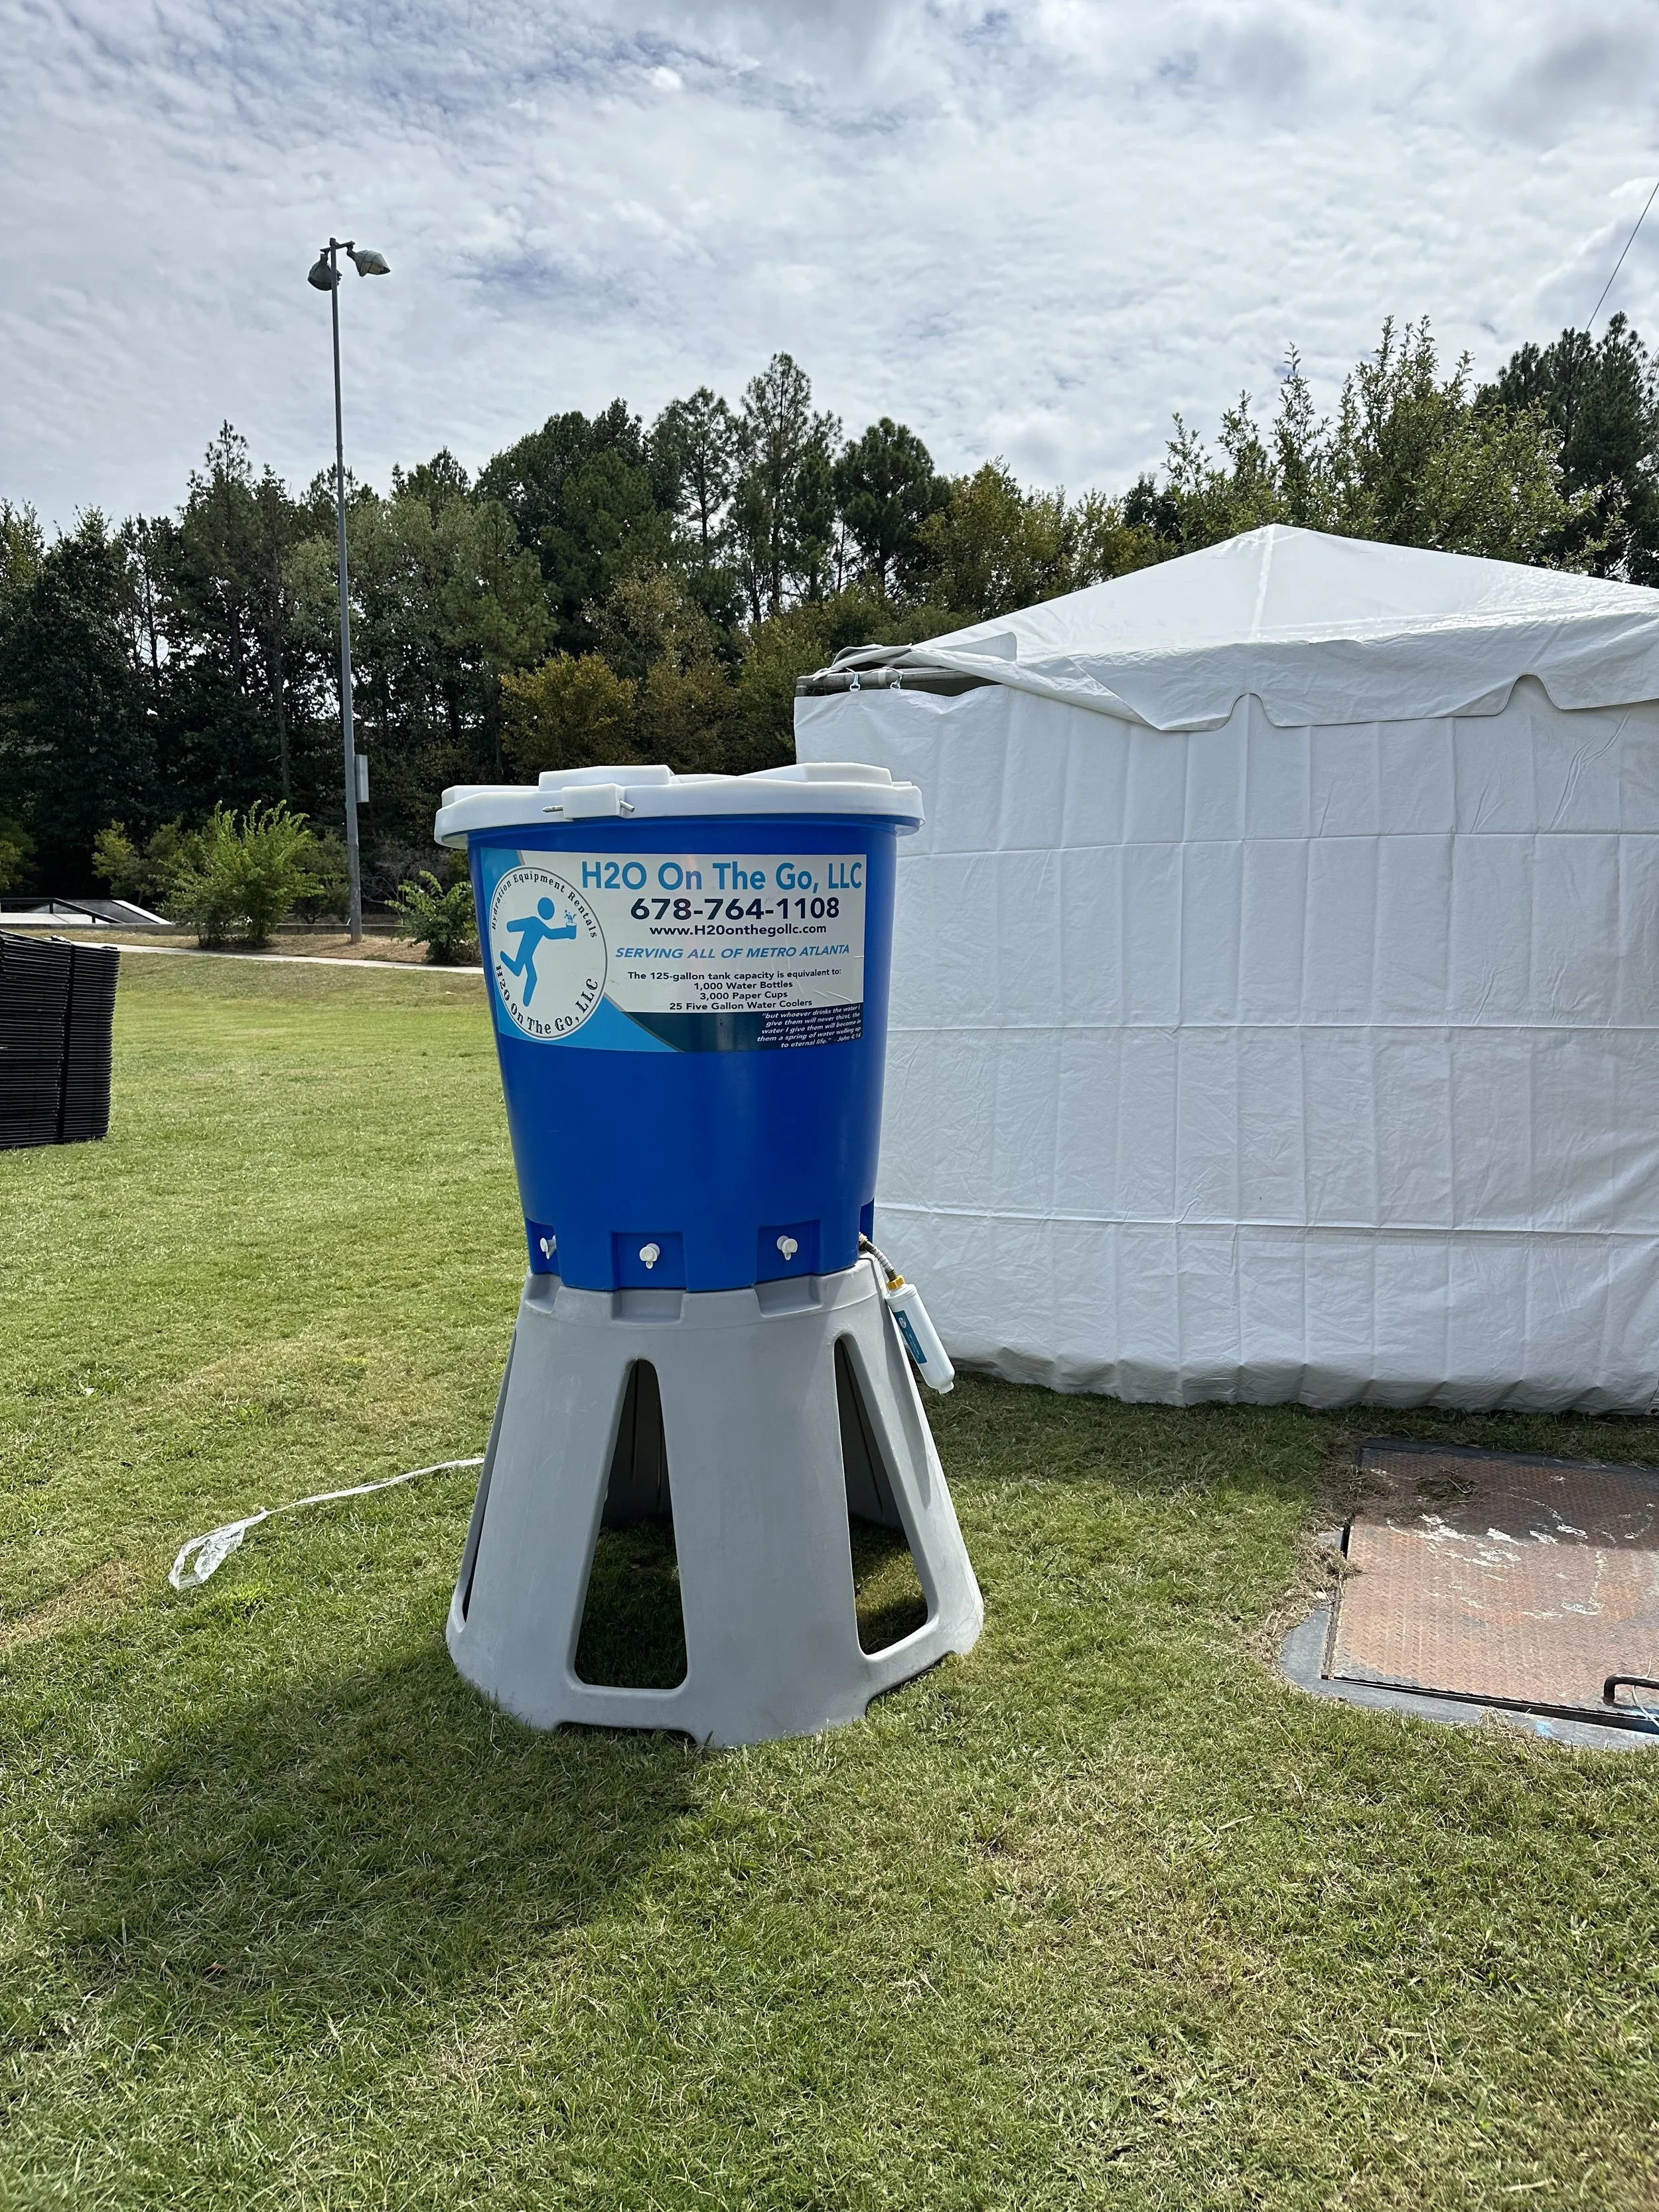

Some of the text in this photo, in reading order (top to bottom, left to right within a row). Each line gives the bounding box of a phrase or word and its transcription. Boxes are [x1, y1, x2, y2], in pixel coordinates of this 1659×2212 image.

[658, 862, 702, 890] On
[713, 861, 766, 890] The
[776, 862, 818, 893] Go,
[828, 861, 862, 889] LLC
[492, 871, 597, 938] Hydration Equipment Rentals
[630, 897, 839, 920] 678-764-1108
[616, 944, 850, 958] SERVING ALL OF METRO ATLANTA
[650, 972, 705, 982] 125-gallon
[708, 971, 731, 980] tank
[734, 970, 775, 982] capacity
[787, 969, 830, 980] equivalent
[694, 980, 793, 991] 1,000 Water Bottles
[699, 991, 788, 1001] 3,000 Paper Cups
[511, 1003, 523, 1025] On
[528, 1017, 551, 1034] The
[555, 1016, 579, 1031] Go,
[575, 978, 598, 1013] LLC
[711, 1001, 743, 1009] Gallon
